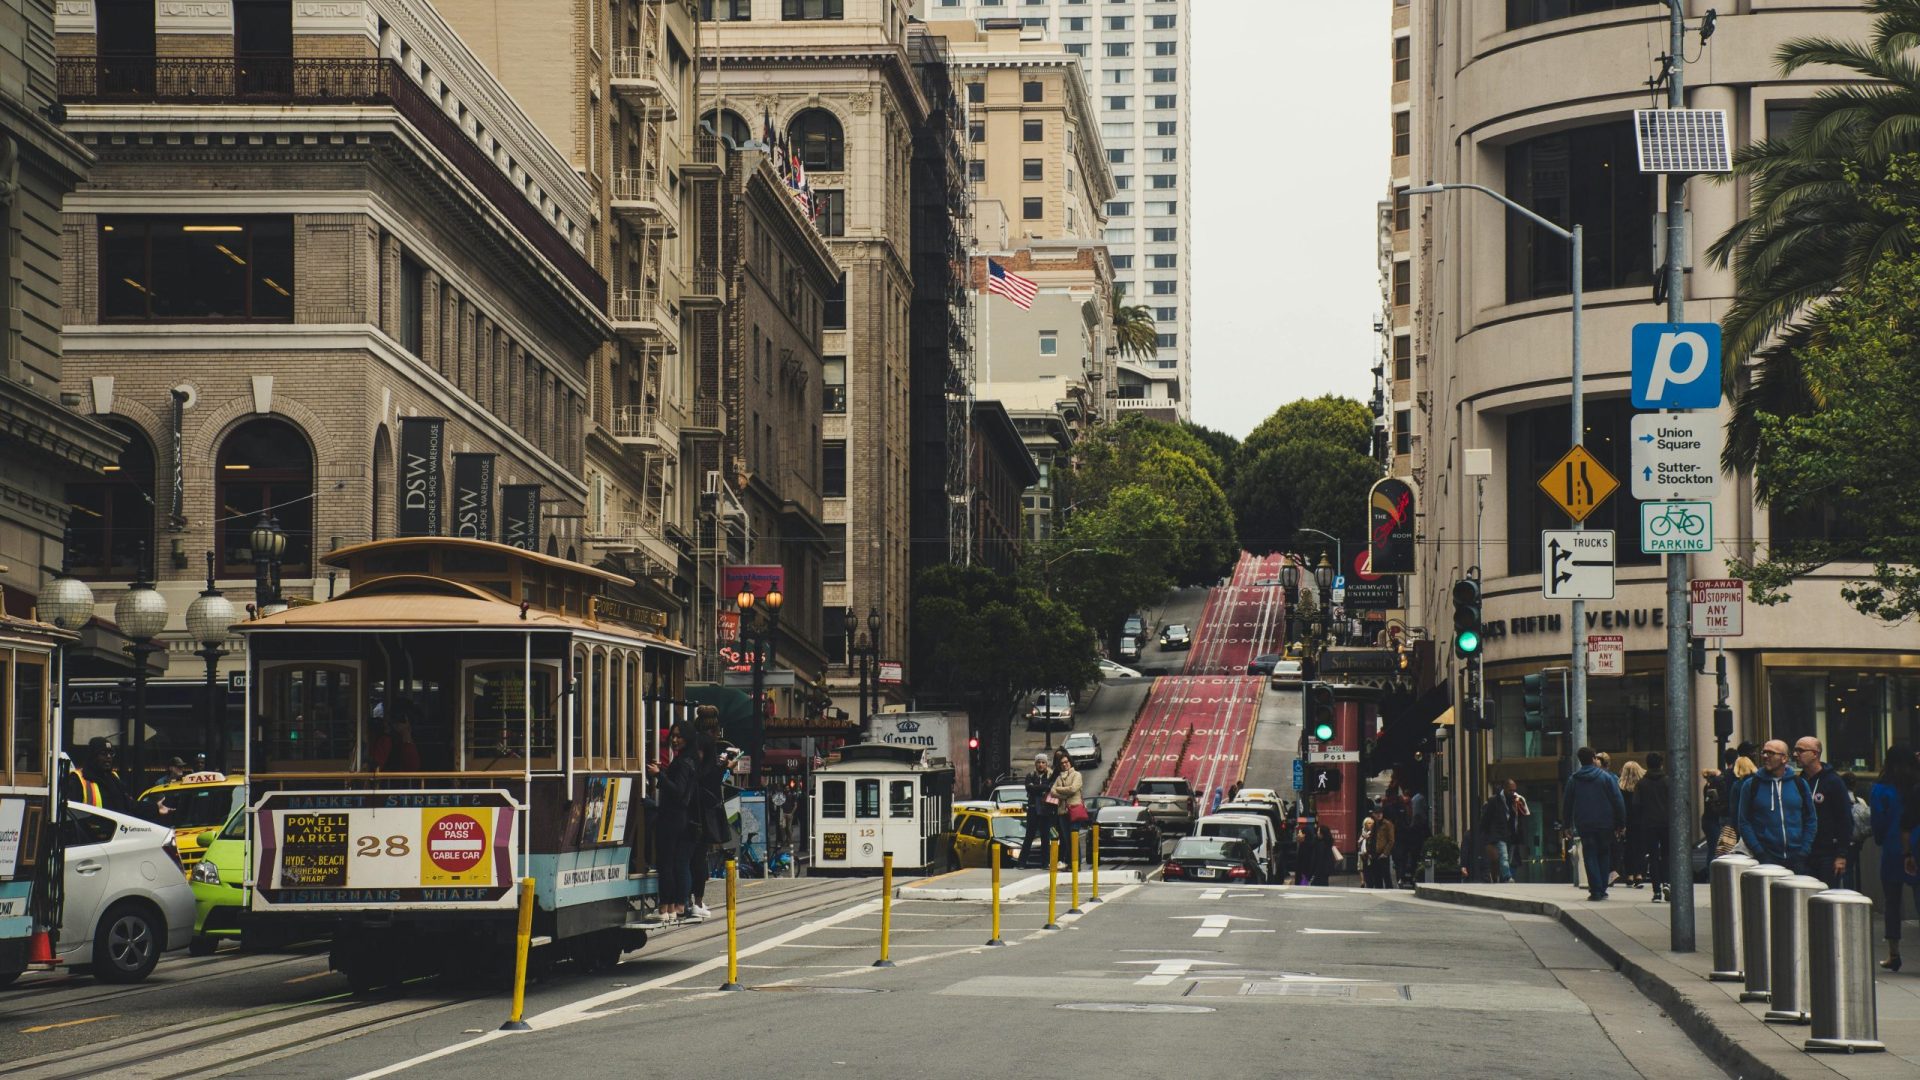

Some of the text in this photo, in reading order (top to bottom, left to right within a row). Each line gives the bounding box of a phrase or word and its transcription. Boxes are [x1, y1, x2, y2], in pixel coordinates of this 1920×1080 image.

[1657, 428, 1692, 438] Union
[430, 424, 438, 473] WAREHOUSE
[1657, 439, 1701, 452] Square
[1657, 462, 1700, 473] Sutter-
[406, 453, 426, 510] DSW
[480, 460, 490, 506] WAREHOUSE
[1657, 474, 1713, 484] Stockton
[458, 488, 478, 538] DSW
[1573, 538, 1608, 548] TRUCKS
[1651, 540, 1704, 549] PARKING
[1692, 590, 1741, 602] NO STOPPING
[1707, 605, 1727, 615] ANY
[1510, 614, 1561, 634] FIFTH
[1585, 608, 1664, 628] VENUE
[1706, 616, 1728, 626] TIME
[1589, 642, 1598, 651] NO
[71, 691, 104, 703] ASE
[884, 733, 934, 746] Corona
[787, 759, 798, 767] 80
[188, 774, 217, 782] TAXI
[288, 796, 364, 808] MARKET
[385, 794, 464, 806] STREET
[288, 817, 346, 826] POWELL
[439, 822, 453, 830] DO
[860, 828, 875, 837] 12
[286, 833, 347, 843] MARKET
[356, 835, 410, 857] 28
[285, 856, 305, 866] HYDE
[318, 856, 345, 866] BEACH
[278, 888, 488, 901] FISHERMANS WHARF
